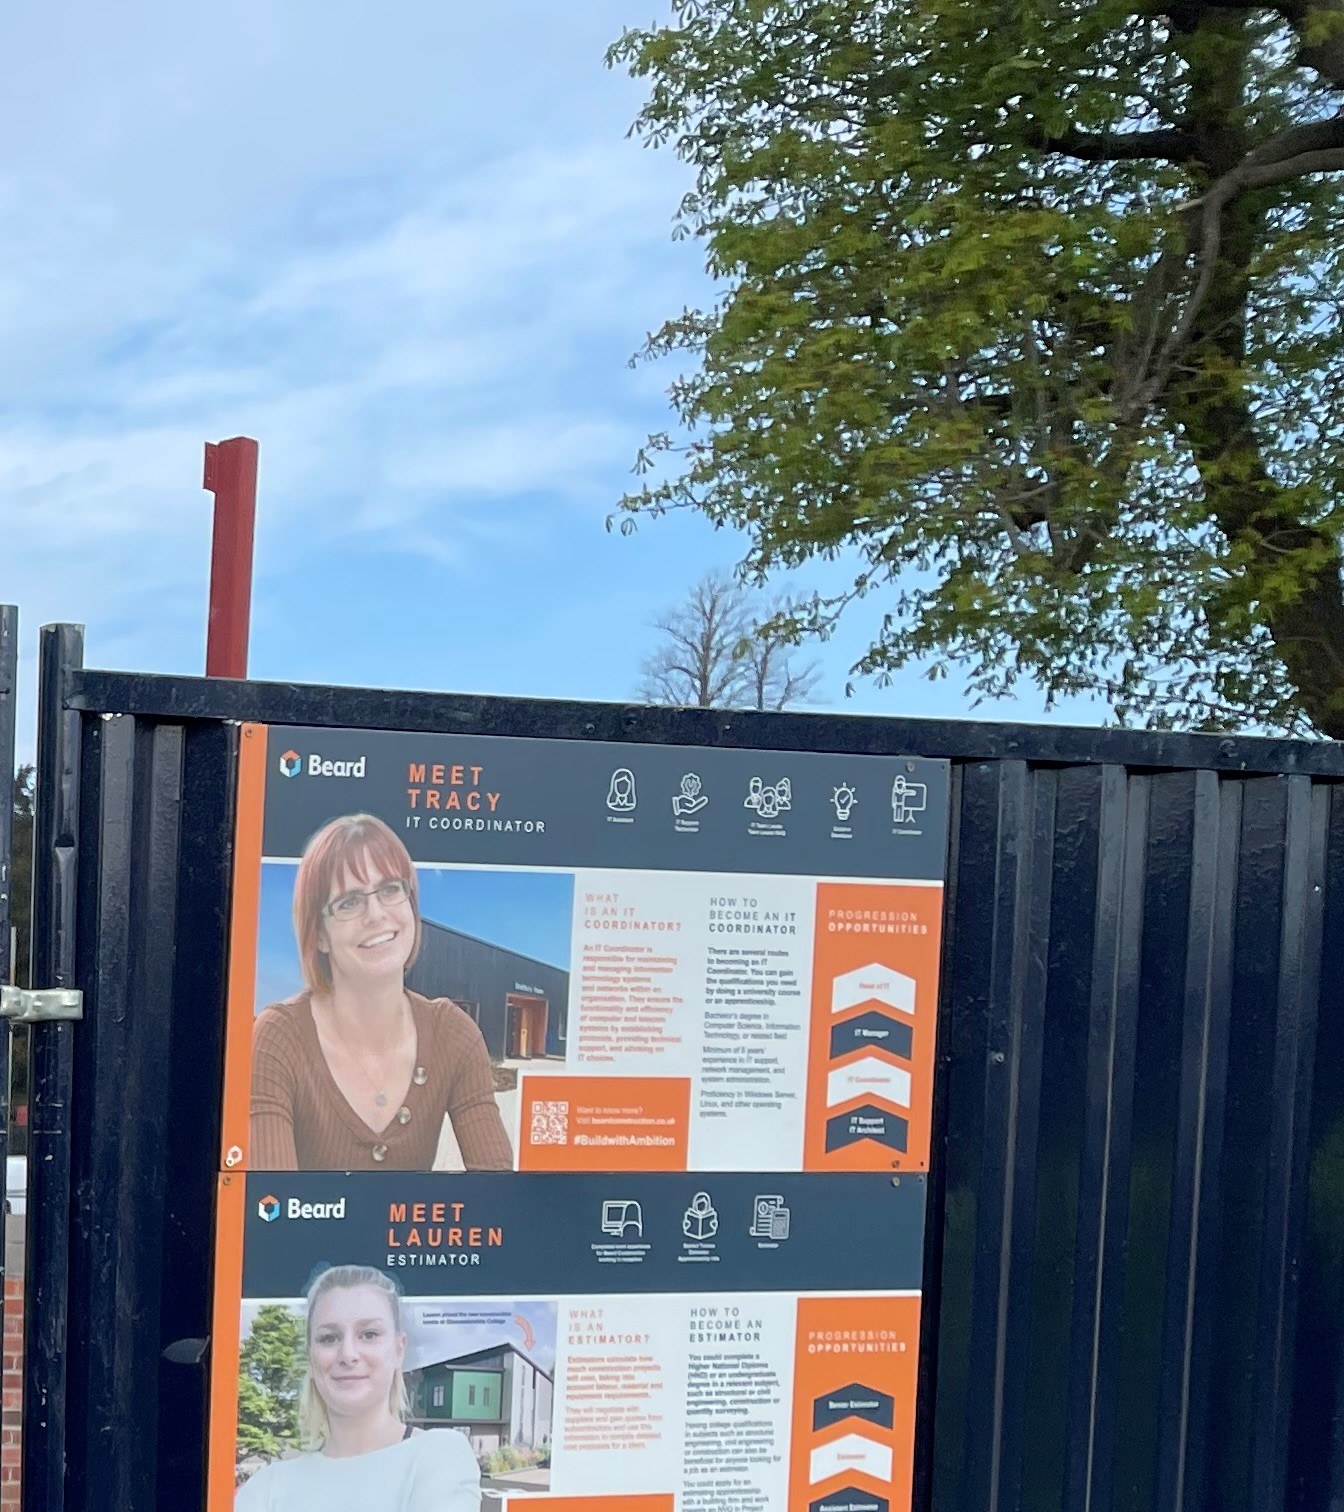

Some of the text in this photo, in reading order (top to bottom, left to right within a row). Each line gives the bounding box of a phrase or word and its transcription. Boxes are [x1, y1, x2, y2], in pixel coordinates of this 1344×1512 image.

[308, 754, 365, 777] Beard
[409, 763, 483, 785] MEET
[408, 789, 500, 811] TRACY
[406, 816, 544, 833] IT COORDINATOR
[585, 893, 619, 903] WHAT
[710, 897, 757, 908] HOW TO
[585, 906, 635, 917] IS AN IT
[710, 910, 796, 921] BECOME AN IT
[584, 920, 681, 931] COORDINATOR?
[709, 923, 795, 935] COORDINATOR
[574, 1134, 675, 1146] #BuildwithAmbition
[288, 1198, 345, 1219] Beard
[390, 1203, 464, 1223] MEET
[389, 1228, 502, 1246] LAUREN
[387, 1254, 479, 1267] ESTIMATOR
[569, 1309, 603, 1319] WHAT
[690, 1307, 739, 1317] HOW TO
[569, 1323, 603, 1332] IS AN
[690, 1320, 762, 1330] BECOME AN
[568, 1334, 649, 1344] ESTIMATOR?
[689, 1332, 760, 1342] ESTIMATOR
